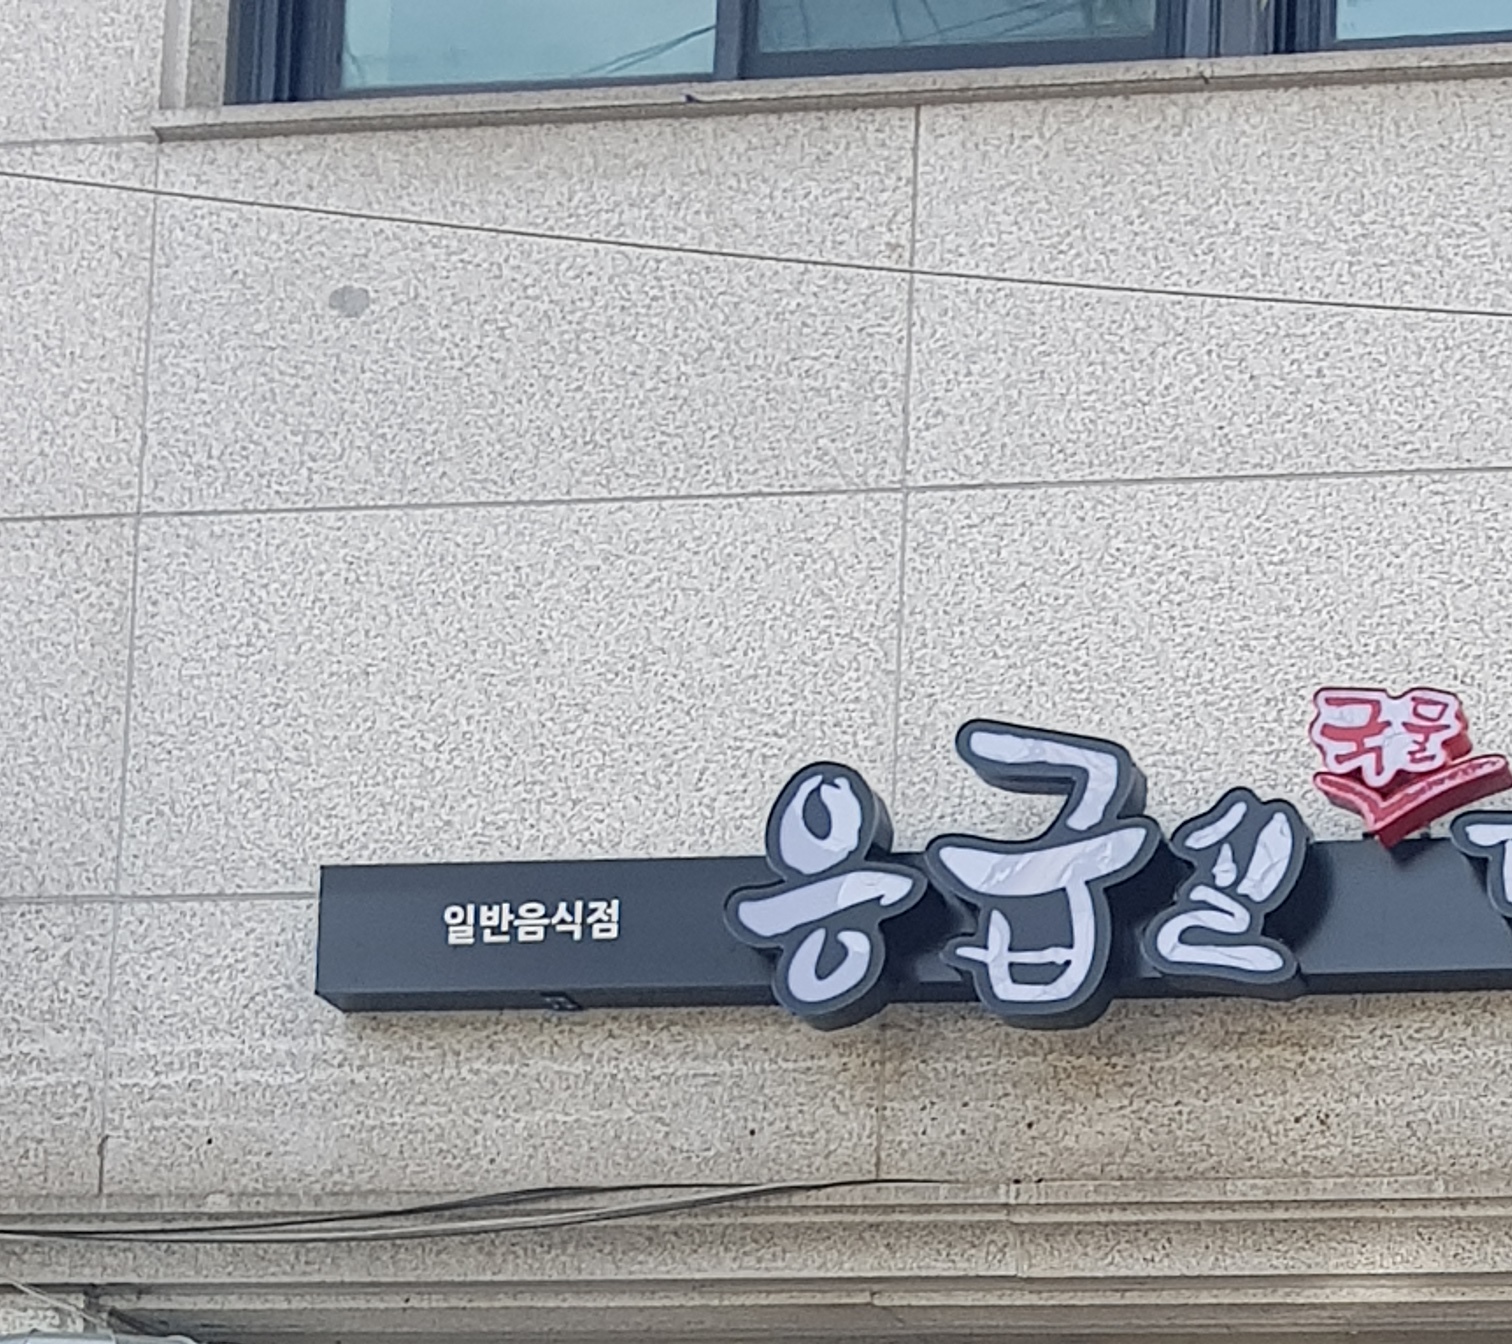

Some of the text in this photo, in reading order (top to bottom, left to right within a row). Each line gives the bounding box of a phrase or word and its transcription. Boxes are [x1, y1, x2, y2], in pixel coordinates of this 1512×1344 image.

[1311, 690, 1467, 787] 국물
[728, 722, 1297, 1015] 응급실
[441, 898, 622, 948] 일반음식점
